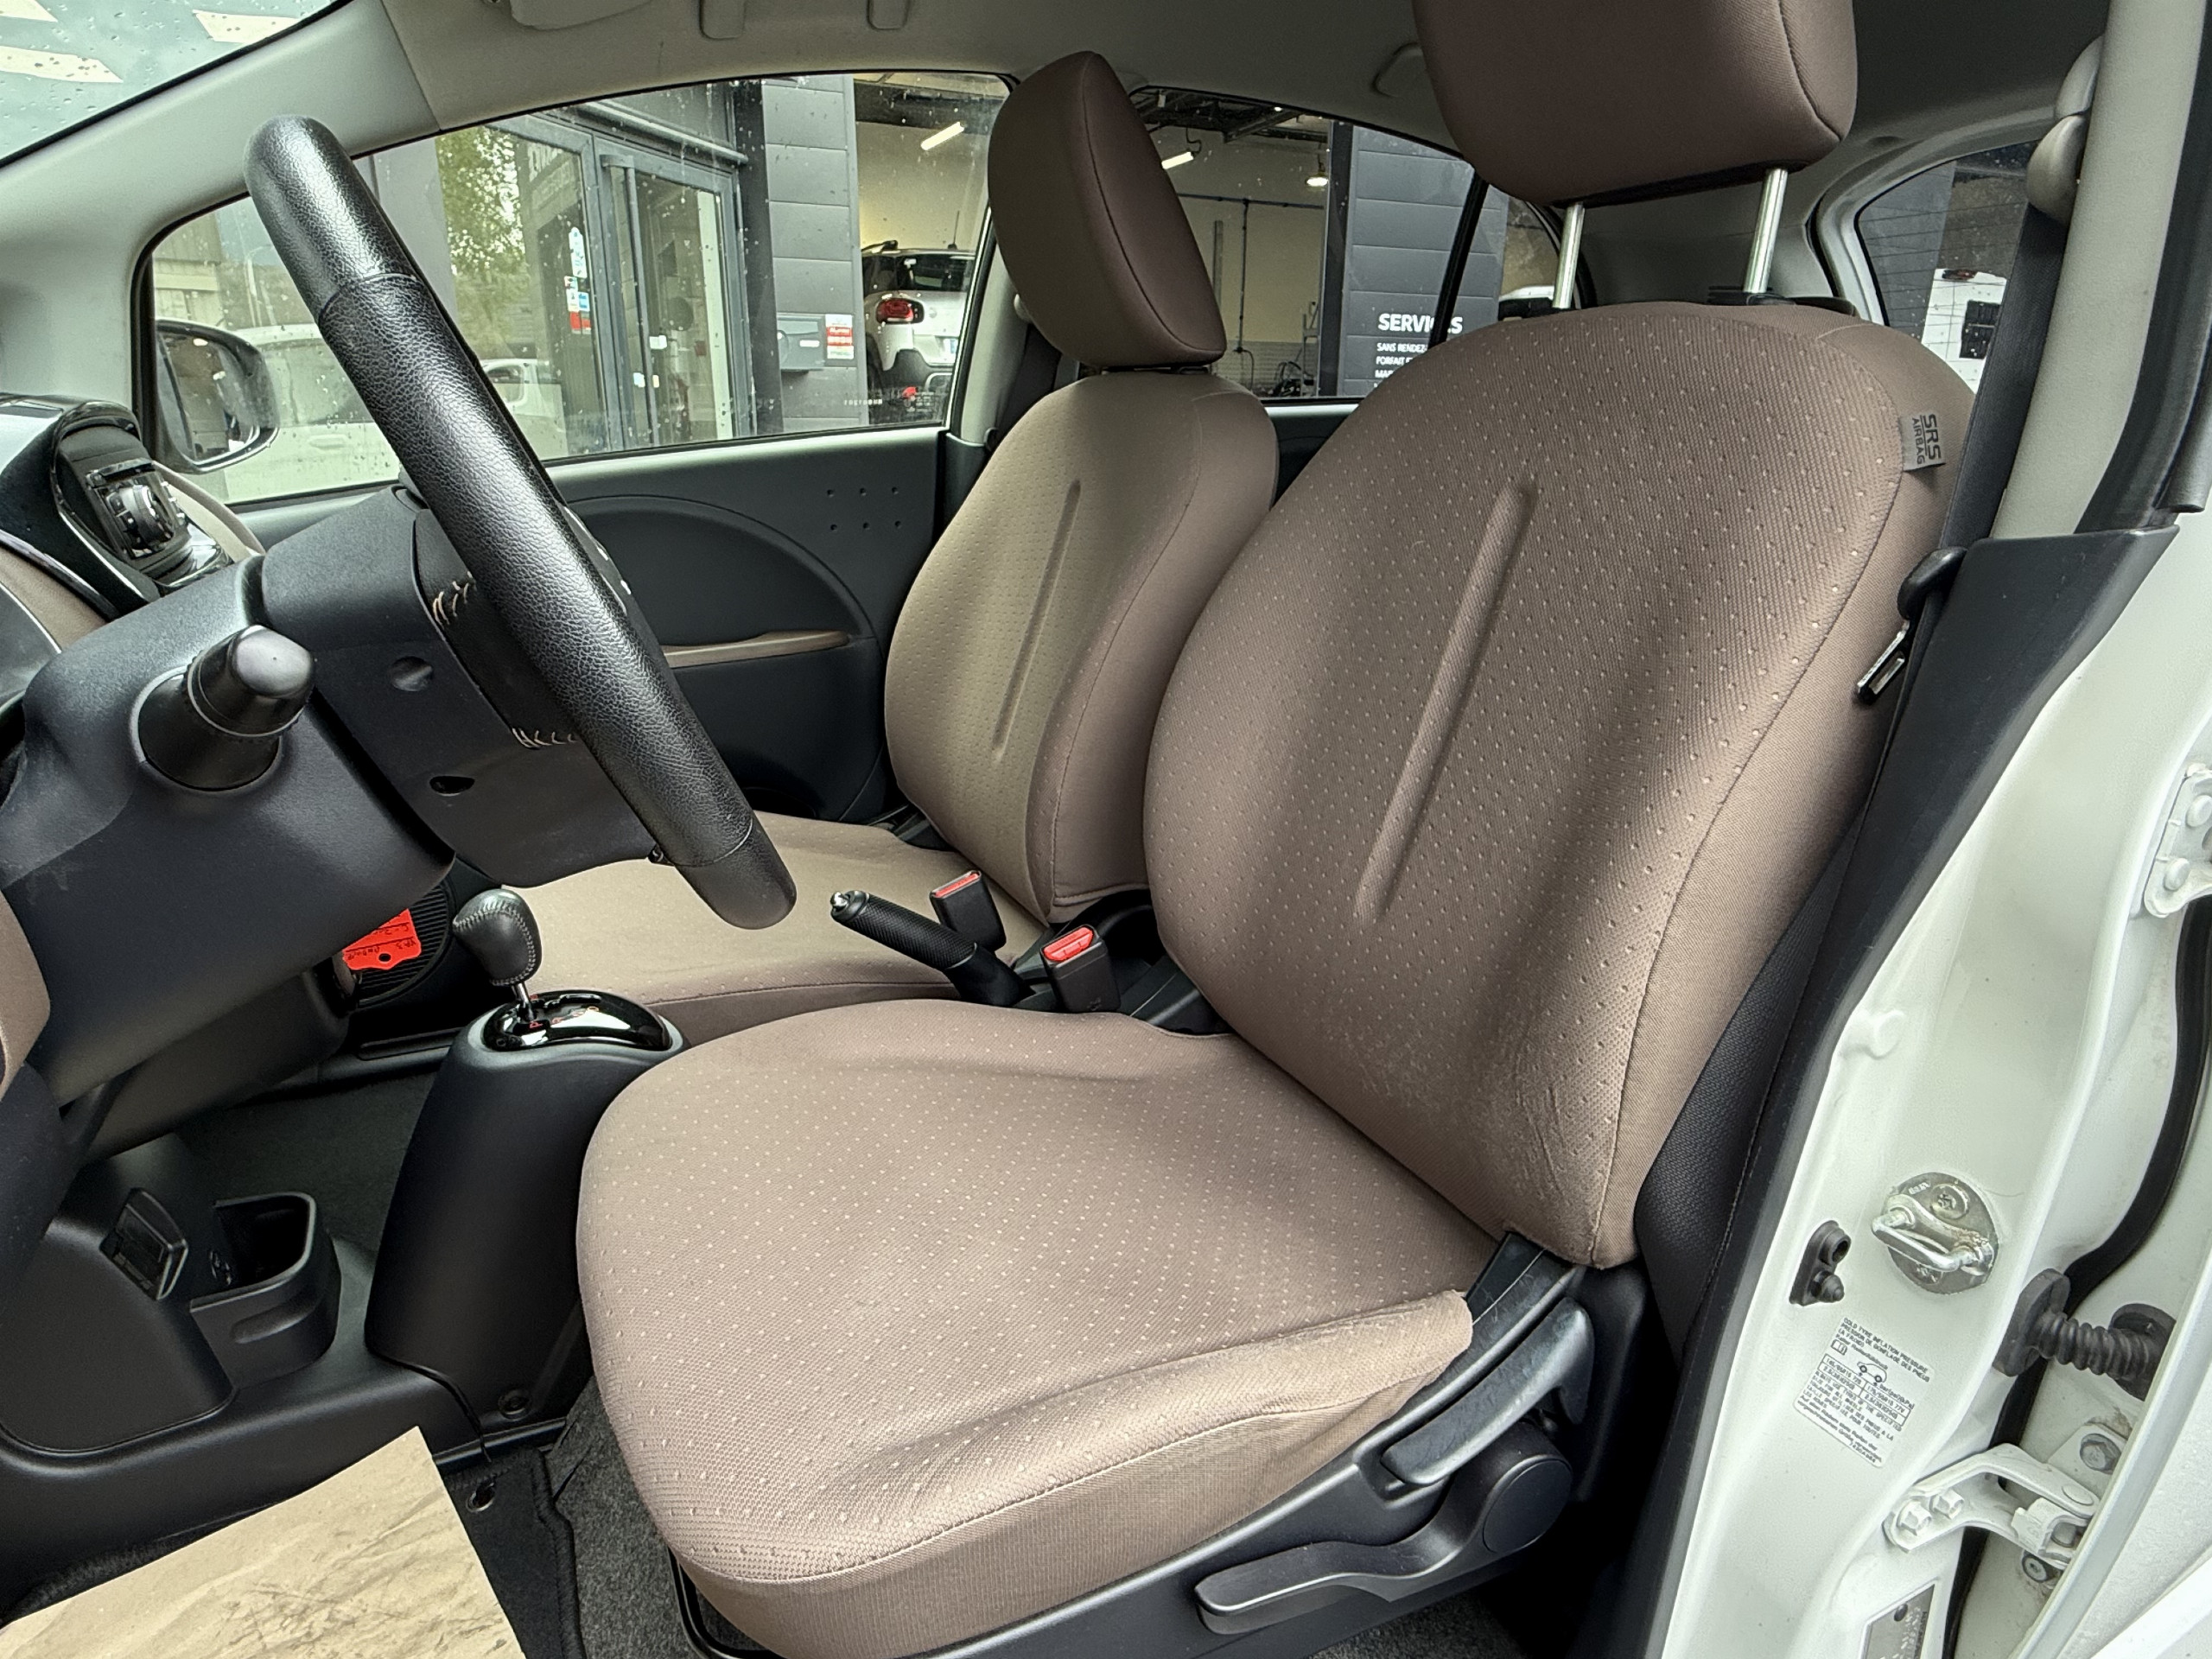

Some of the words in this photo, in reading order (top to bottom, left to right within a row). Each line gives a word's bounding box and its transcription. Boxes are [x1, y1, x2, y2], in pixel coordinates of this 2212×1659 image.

[1378, 313, 1463, 334] SERVIS
[1376, 342, 1397, 353] SANS
[1376, 355, 1404, 366] FORFAIT
[1912, 417, 1925, 465] AIRBAG
[1923, 413, 1942, 460] SRS
[1842, 1317, 1858, 1329] COLD
